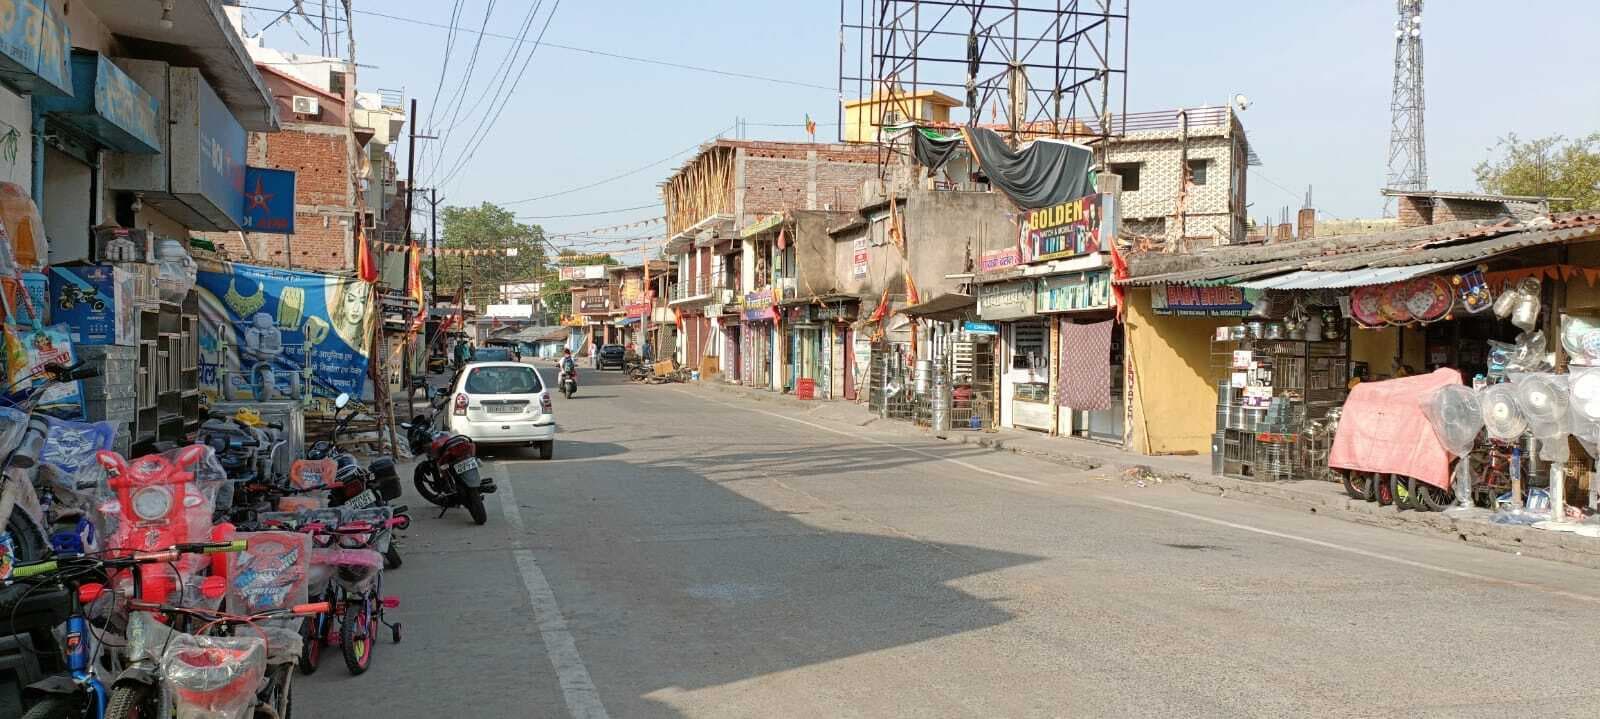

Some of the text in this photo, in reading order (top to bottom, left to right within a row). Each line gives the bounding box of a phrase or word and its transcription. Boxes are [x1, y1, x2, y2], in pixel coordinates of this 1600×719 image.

[1030, 199, 1083, 230] GOLDEN
[1167, 286, 1242, 306] BABA SHOES
